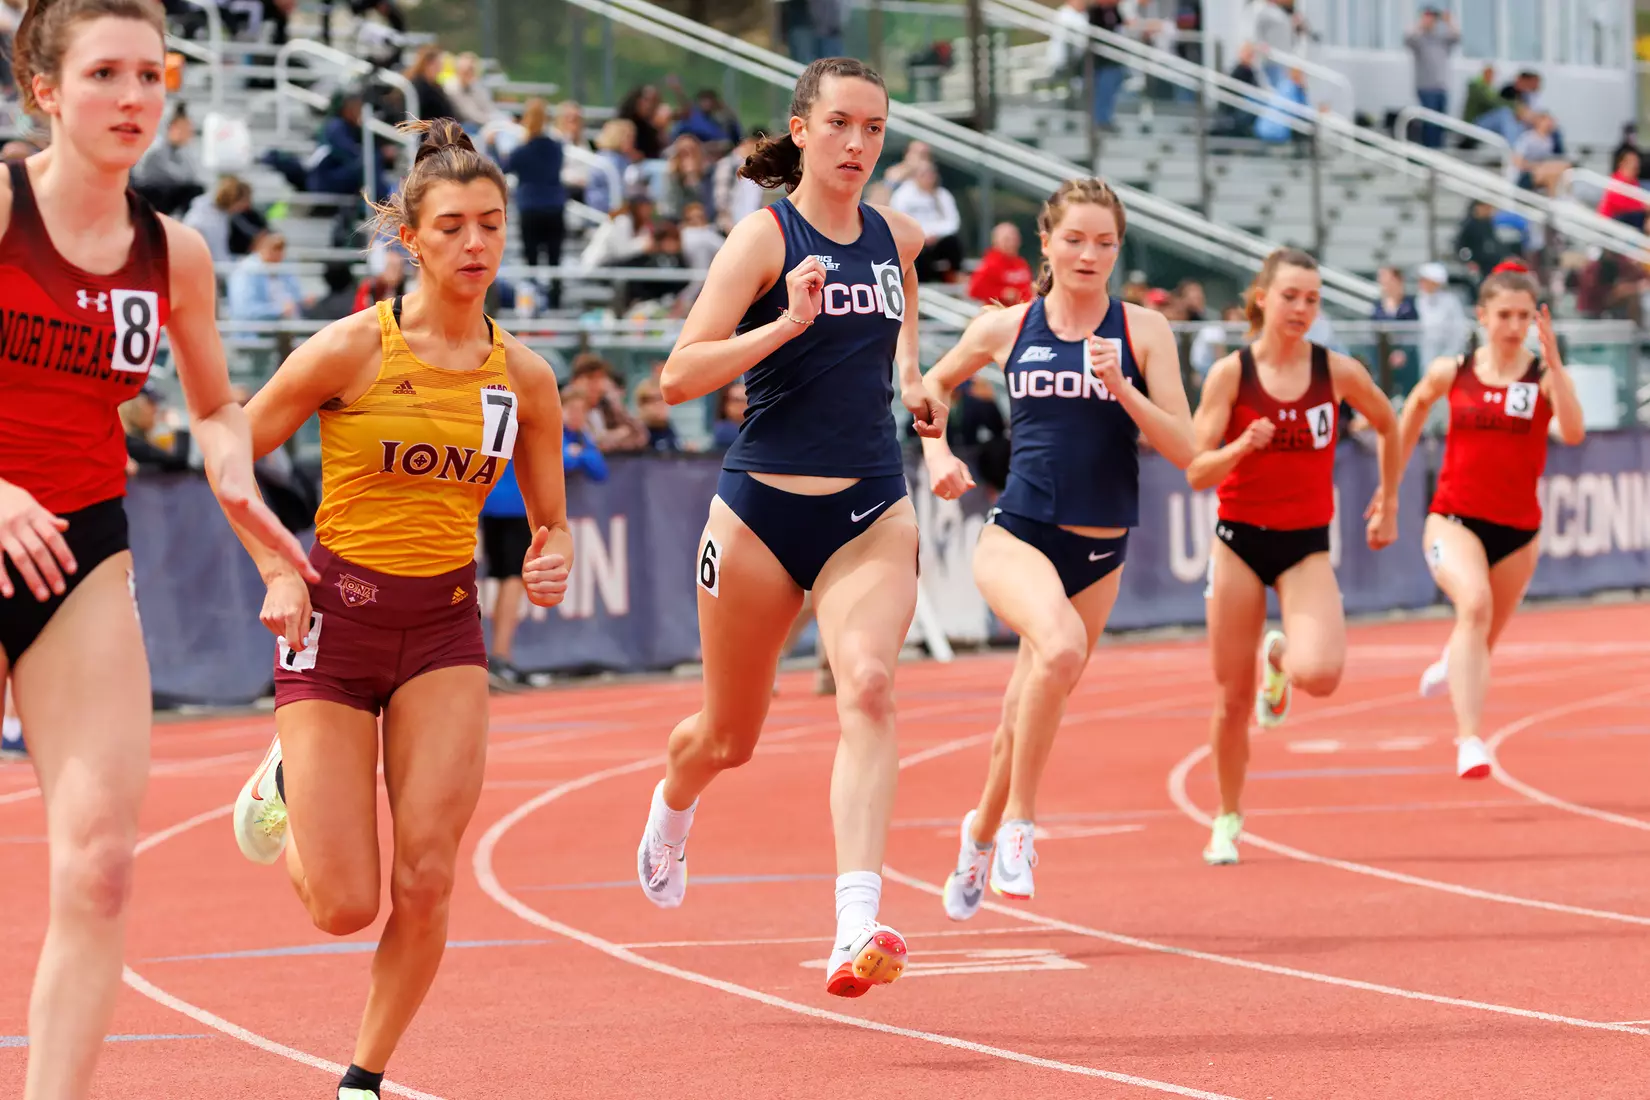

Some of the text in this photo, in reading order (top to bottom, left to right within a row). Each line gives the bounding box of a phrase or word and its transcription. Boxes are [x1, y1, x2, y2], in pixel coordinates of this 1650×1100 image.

[880, 268, 903, 317] 6
[122, 296, 151, 366] 8
[1008, 369, 1133, 402] UCON
[1512, 384, 1531, 412] 3
[486, 394, 513, 453] 7
[1317, 409, 1330, 440] 4
[380, 440, 498, 485] IONA
[701, 539, 717, 589] 6
[341, 578, 373, 598] IONA
